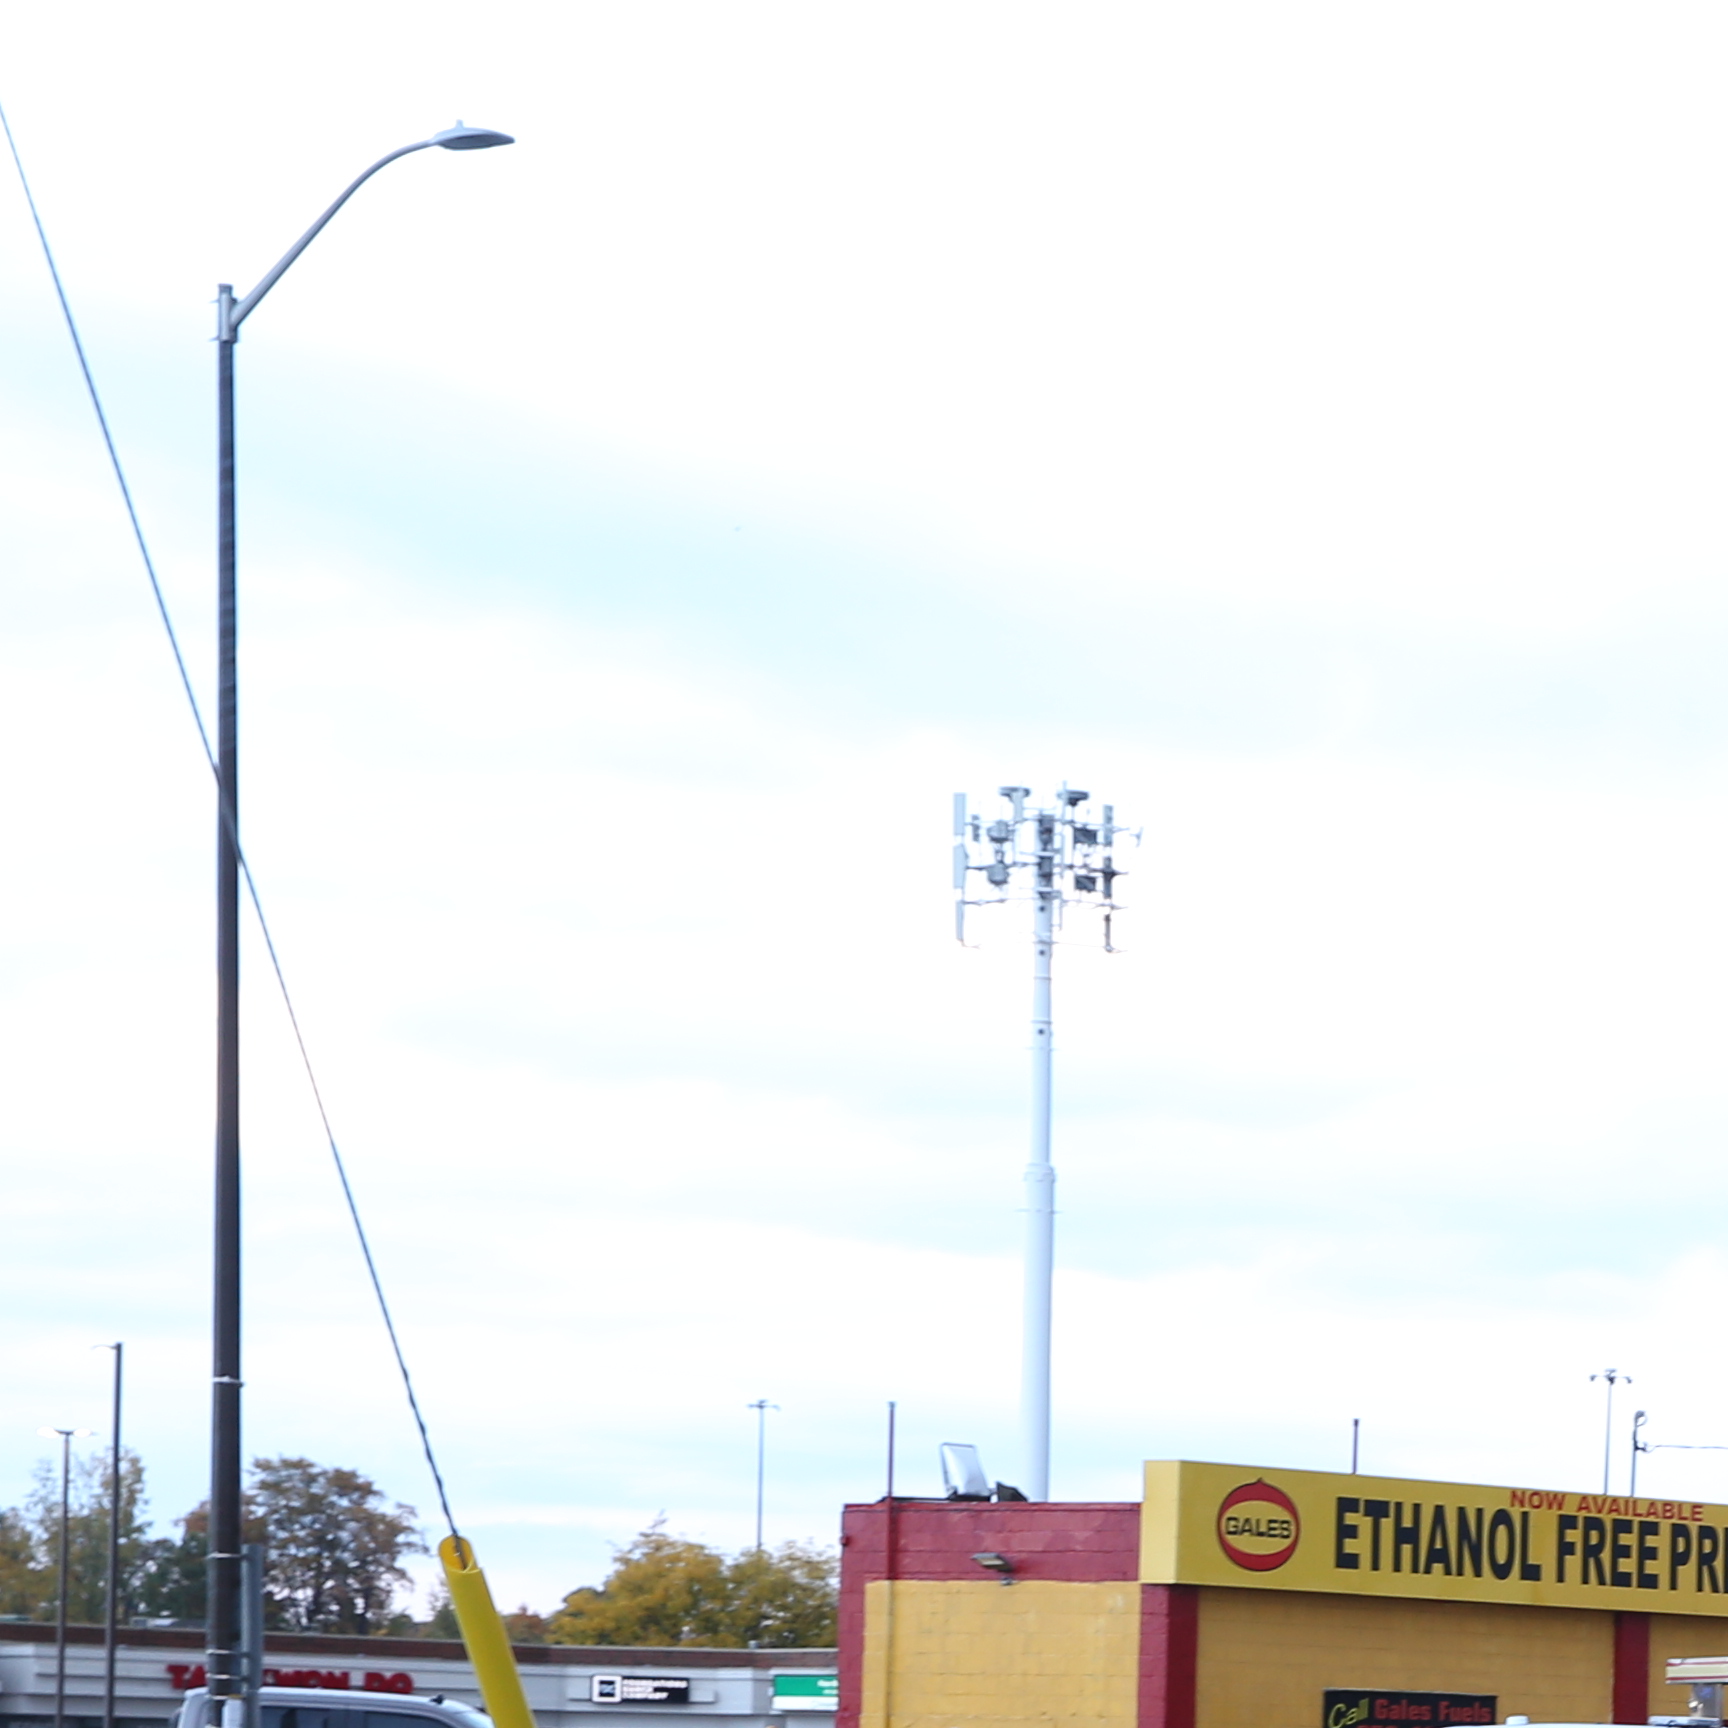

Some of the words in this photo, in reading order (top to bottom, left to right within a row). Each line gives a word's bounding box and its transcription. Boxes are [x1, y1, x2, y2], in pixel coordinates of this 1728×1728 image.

[1510, 1489, 1566, 1511] NOW
[1577, 1495, 1704, 1521] AVAILABLE
[1225, 1516, 1292, 1539] GALES
[1335, 1496, 1541, 1582] ETHANOL
[1556, 1513, 1660, 1589] FREE
[166, 1664, 208, 1689] TA
[363, 1671, 414, 1694] DO
[1374, 1699, 1432, 1720] Gales
[1438, 1701, 1492, 1722] Fuels
